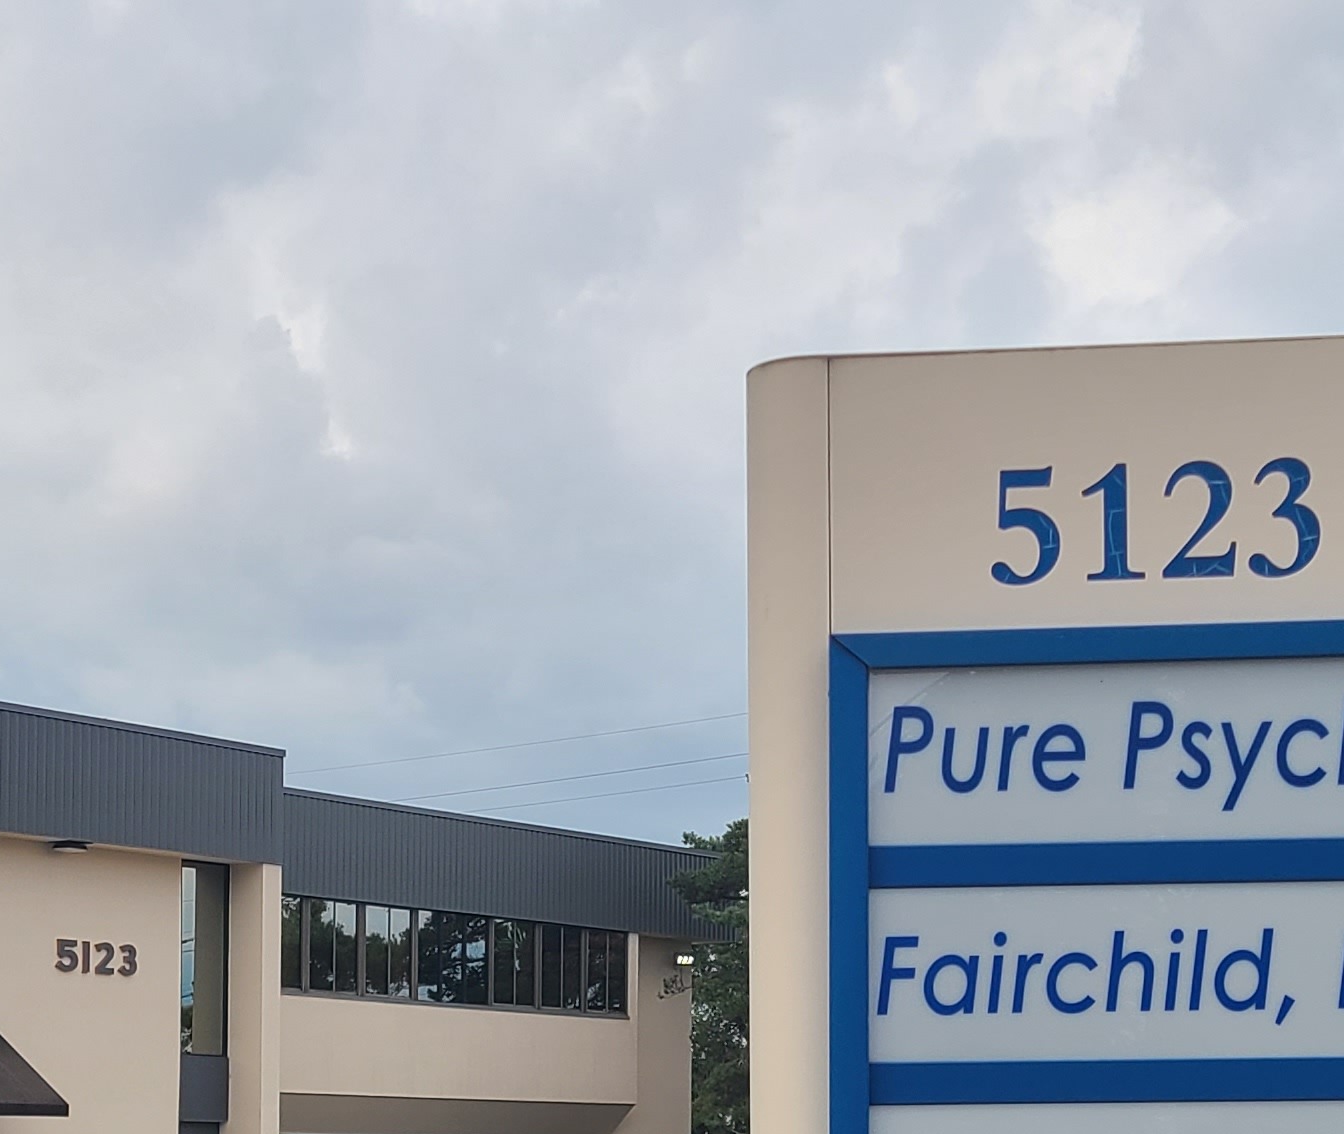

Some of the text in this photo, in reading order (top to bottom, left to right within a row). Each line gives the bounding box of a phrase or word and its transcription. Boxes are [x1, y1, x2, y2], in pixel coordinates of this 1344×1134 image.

[991, 457, 1321, 586] 5123
[883, 704, 1087, 795] Pure
[55, 938, 138, 976] 5123
[875, 927, 1297, 1027] Fairchild,
